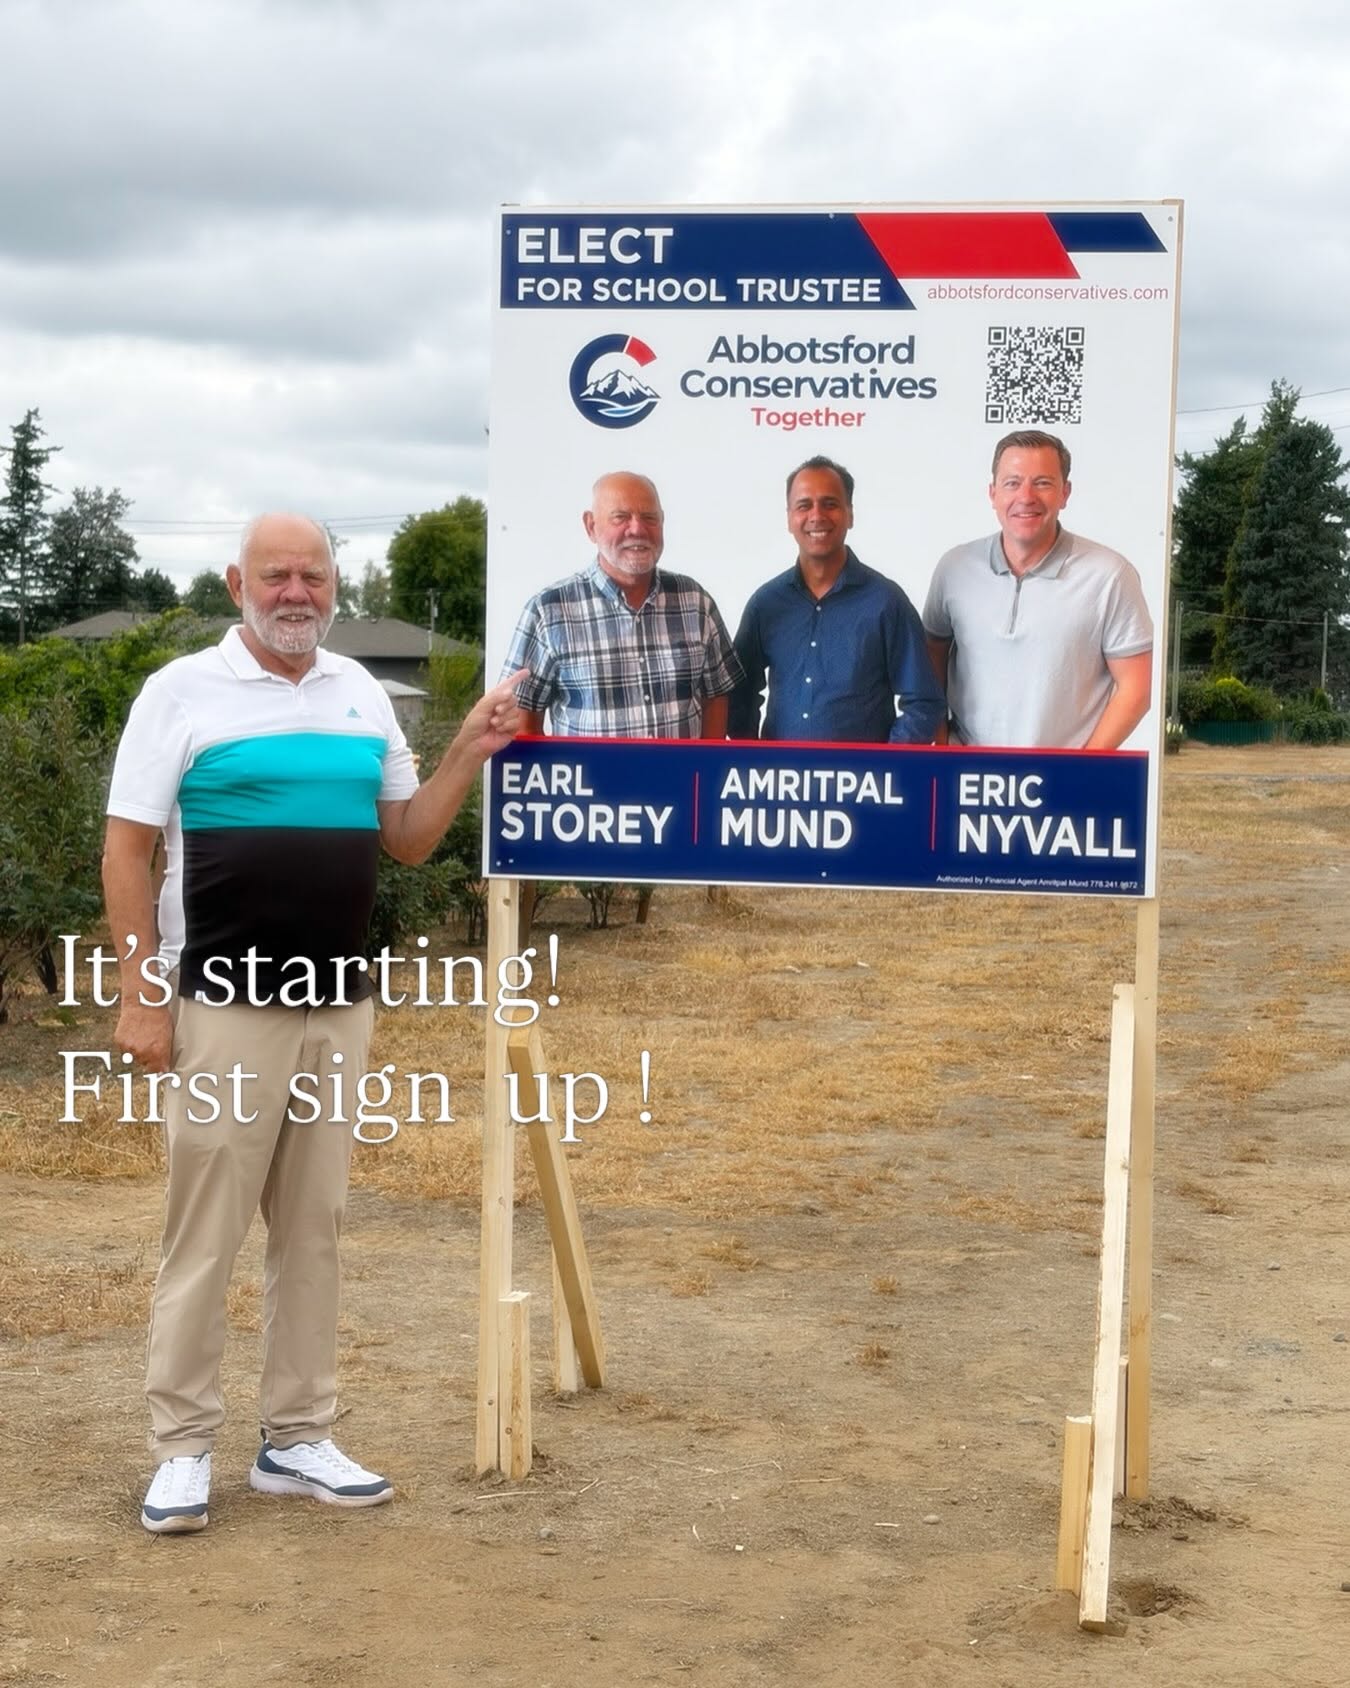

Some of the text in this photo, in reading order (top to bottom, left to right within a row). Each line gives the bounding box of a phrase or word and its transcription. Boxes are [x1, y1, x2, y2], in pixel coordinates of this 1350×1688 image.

[518, 227, 674, 265] ELECT
[518, 277, 881, 302] FOR SCHOOL TRUSTEE
[927, 284, 1169, 300] abbotsfordconservatives.com
[707, 335, 915, 365] Abbotsford
[680, 368, 937, 400] Conservatives
[751, 408, 866, 430] Together
[503, 763, 594, 796] EARL
[721, 768, 903, 805] AMRITPAL
[959, 774, 1043, 808] ERIC
[502, 802, 673, 844] STOREY
[722, 808, 853, 849] MUND
[959, 814, 1137, 858] NYVALL
[936, 874, 974, 884] Authorized
[975, 875, 983, 886] by
[984, 876, 1016, 886] Financial
[1017, 877, 1038, 888] Agent
[1068, 880, 1089, 889] Mund
